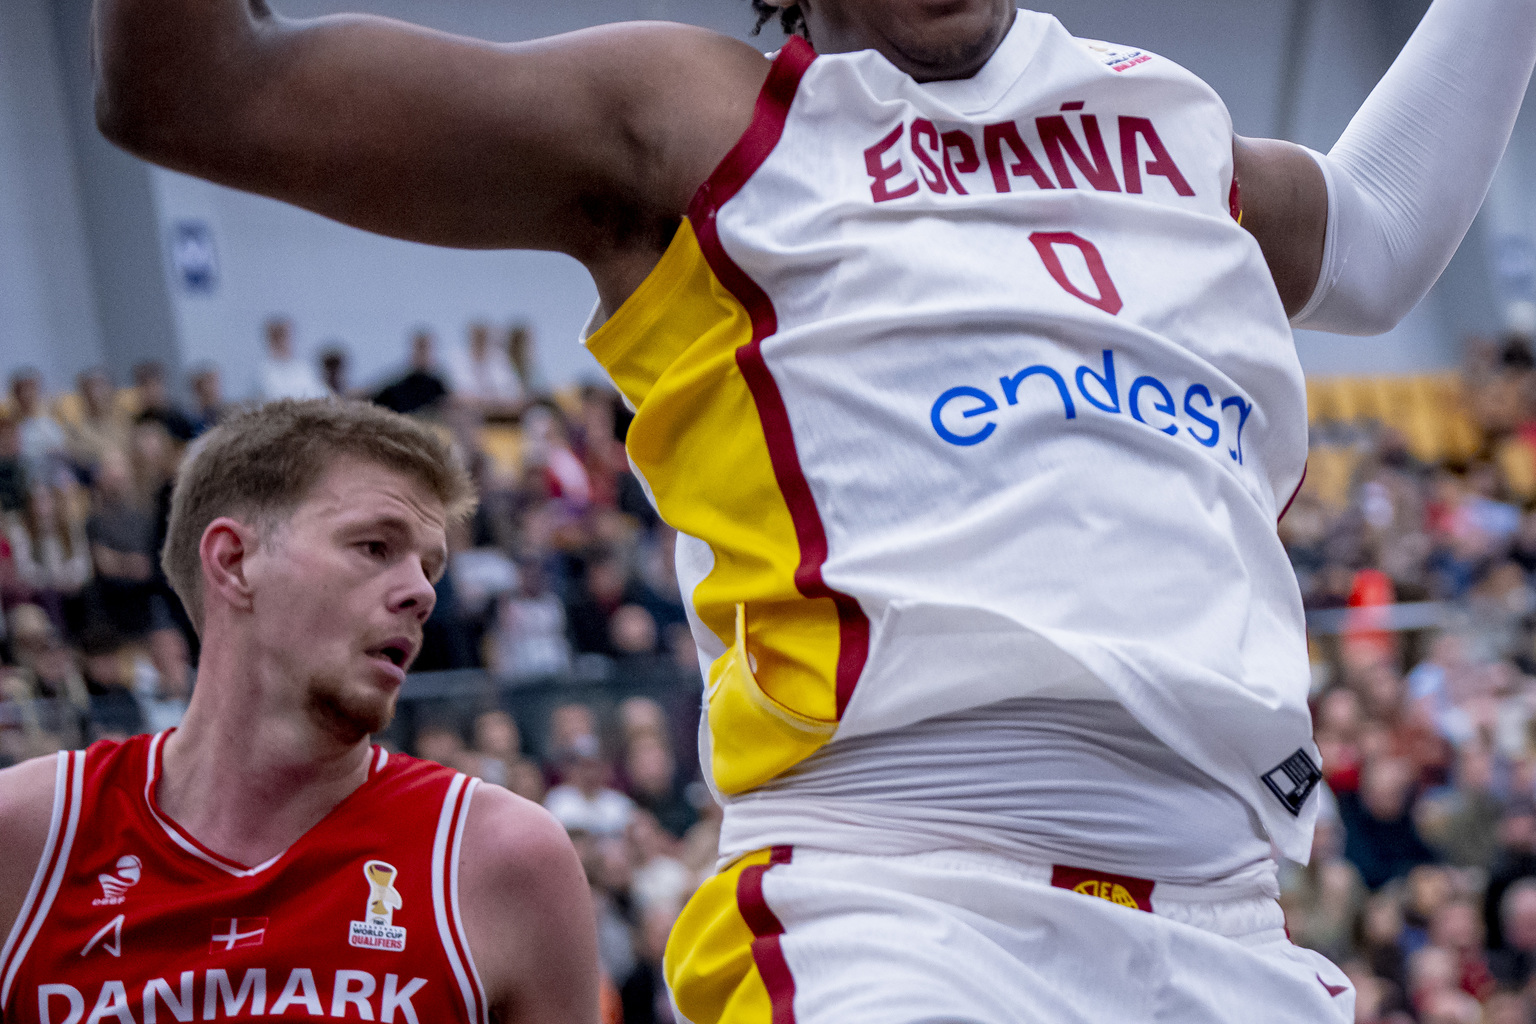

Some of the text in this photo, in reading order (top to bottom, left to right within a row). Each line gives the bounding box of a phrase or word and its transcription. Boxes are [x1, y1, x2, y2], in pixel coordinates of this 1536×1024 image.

[864, 101, 1196, 203] ESPAÑA
[1028, 231, 1124, 316] 0
[351, 934, 403, 949] QUALIFIERS
[353, 927, 384, 937] WORLD
[385, 931, 403, 939] CUP
[38, 968, 428, 1024] DANMARK
